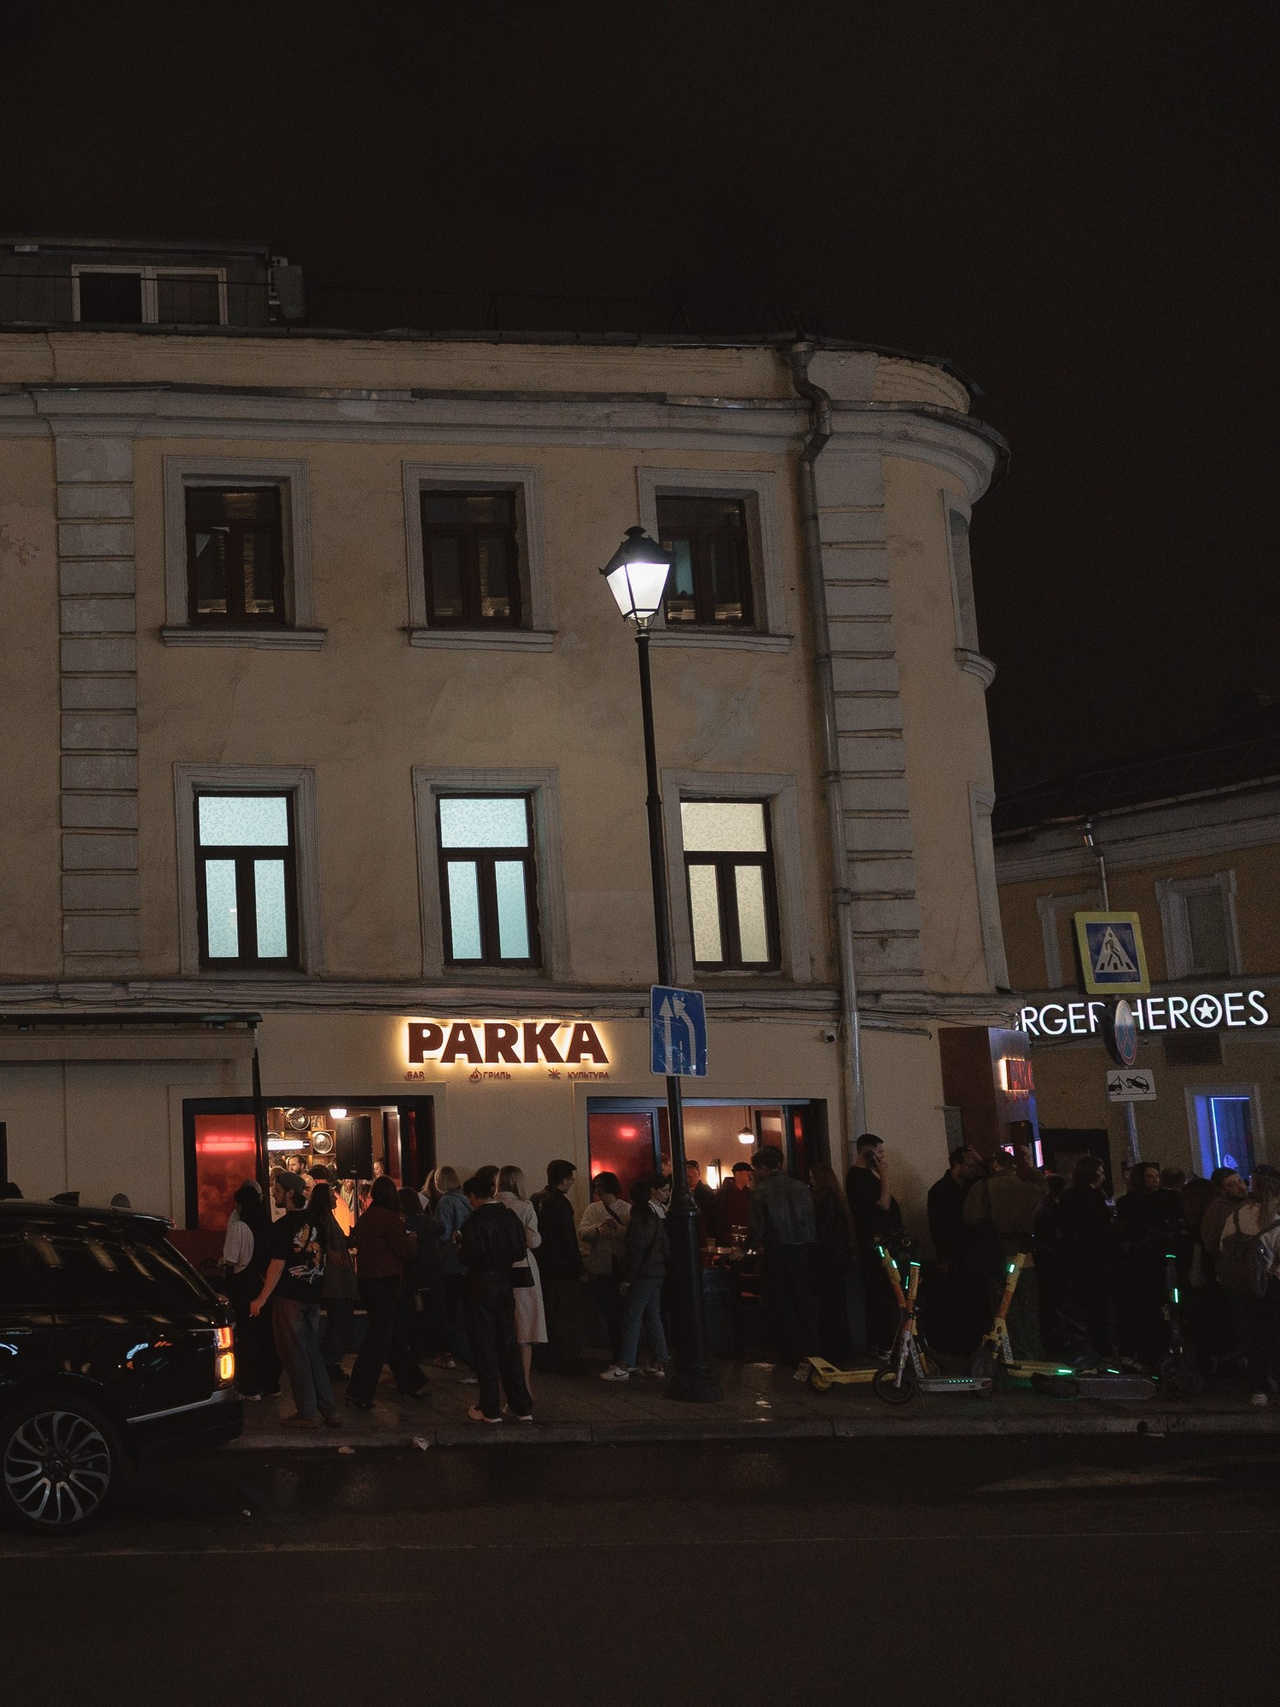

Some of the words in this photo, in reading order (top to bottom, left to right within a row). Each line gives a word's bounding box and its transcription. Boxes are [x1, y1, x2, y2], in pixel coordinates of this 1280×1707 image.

[1014, 1002, 1106, 1036] RGER
[1131, 990, 1269, 1030] HEROES
[408, 1022, 610, 1063] PARKA
[407, 1071, 425, 1079] БАР
[483, 1071, 511, 1079] ГРИЛЬ
[567, 1071, 610, 1079] КУЛЬТУРА
